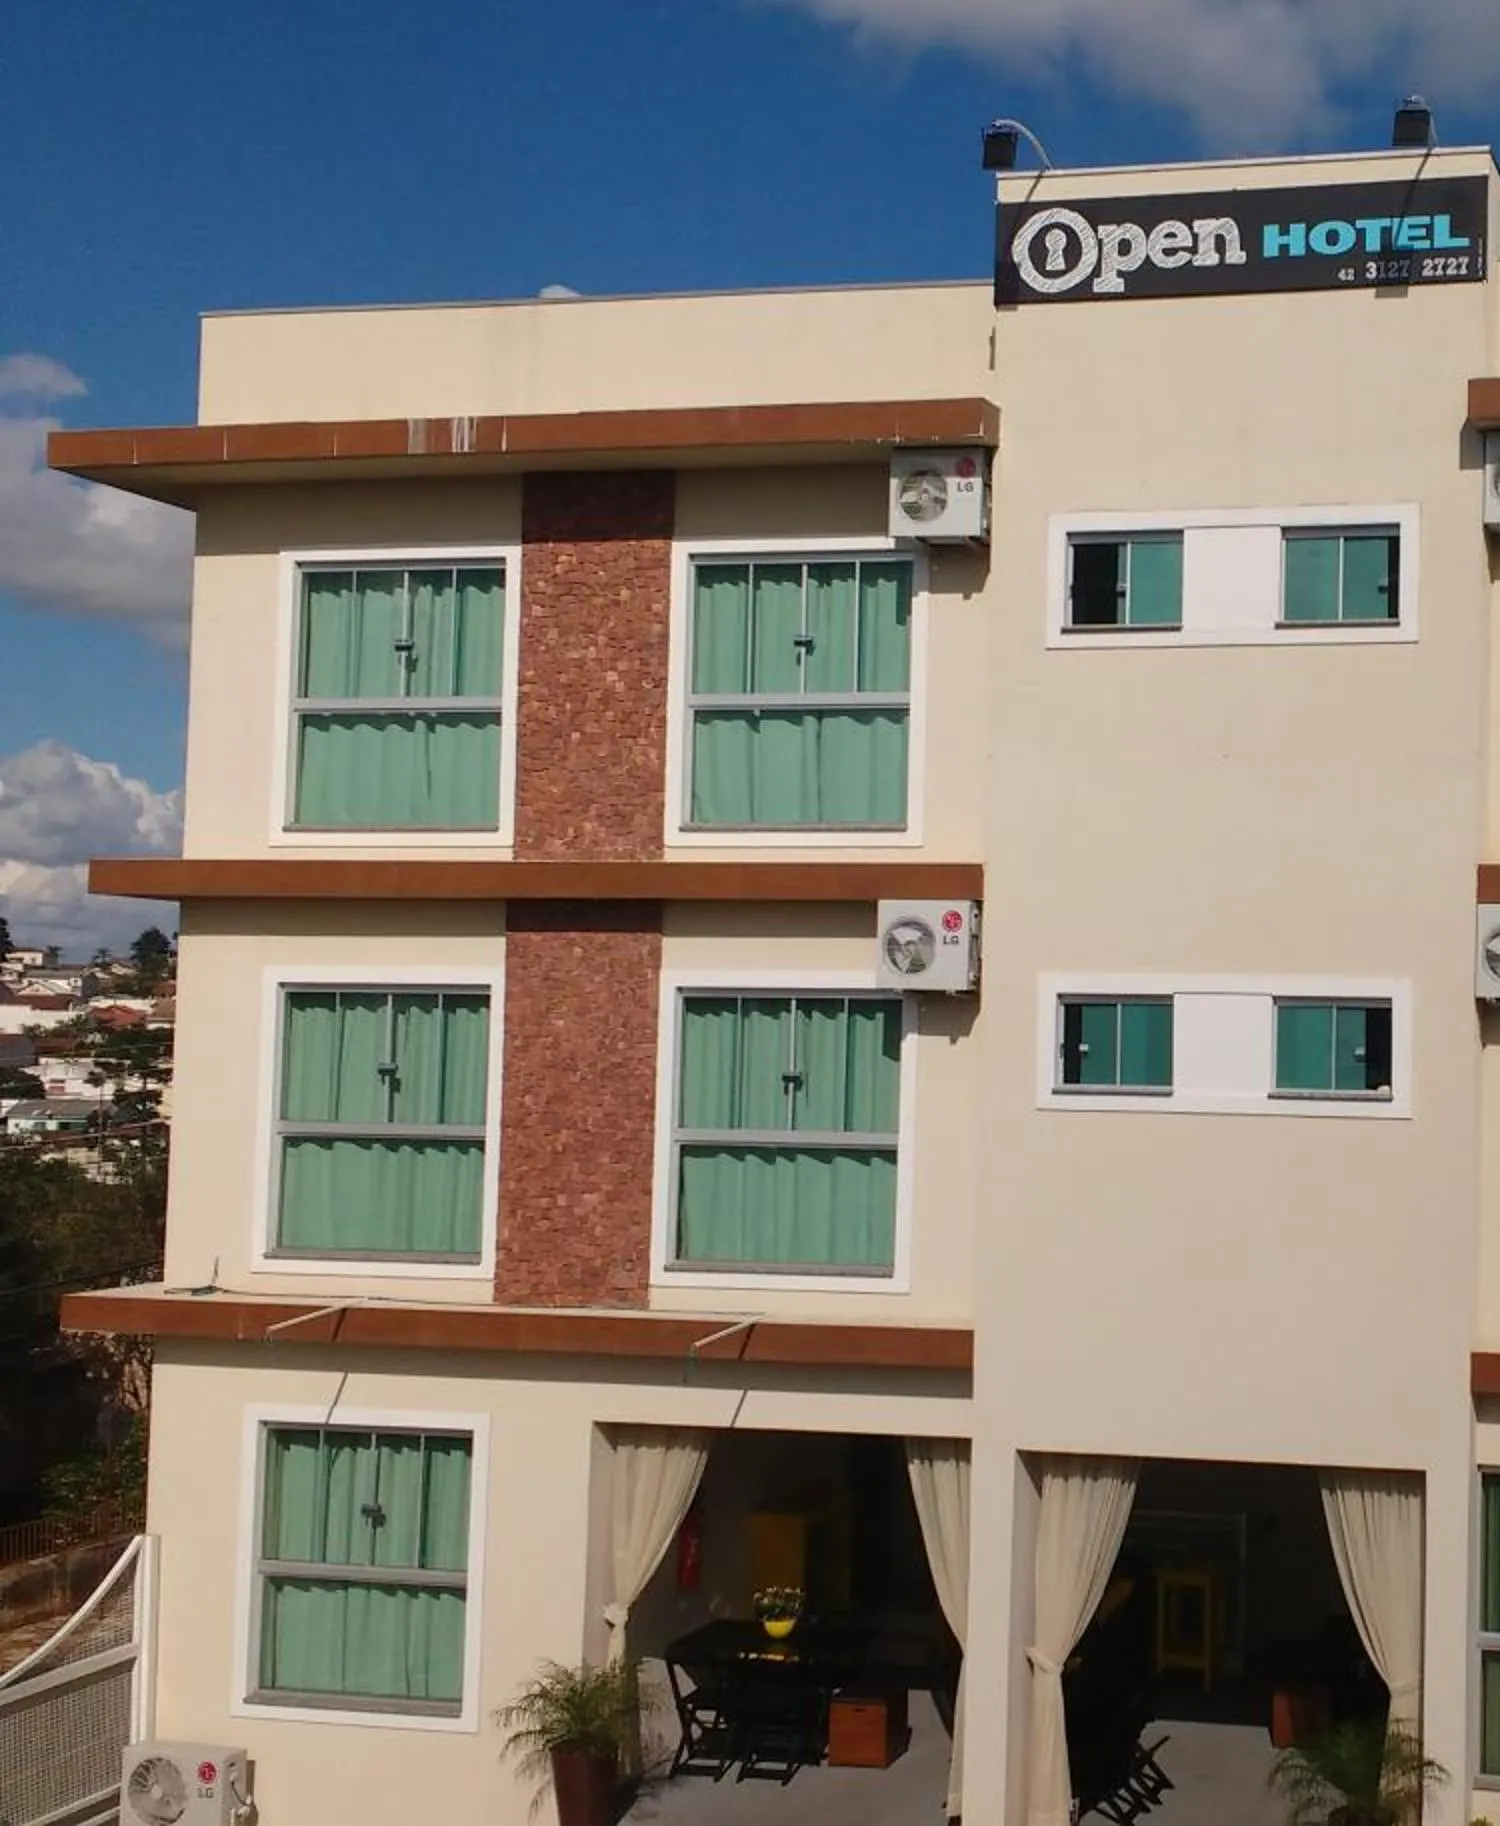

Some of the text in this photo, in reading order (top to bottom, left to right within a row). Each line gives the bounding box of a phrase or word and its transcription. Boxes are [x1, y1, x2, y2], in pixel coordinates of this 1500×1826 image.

[1012, 207, 1247, 293] Open
[1263, 214, 1471, 258] HOTEL
[1337, 268, 1355, 281] 42
[1365, 261, 1411, 279] 3127
[1421, 256, 1469, 277] 2727
[956, 481, 974, 493] LG
[943, 935, 960, 945] LG
[197, 1787, 214, 1799] LG
